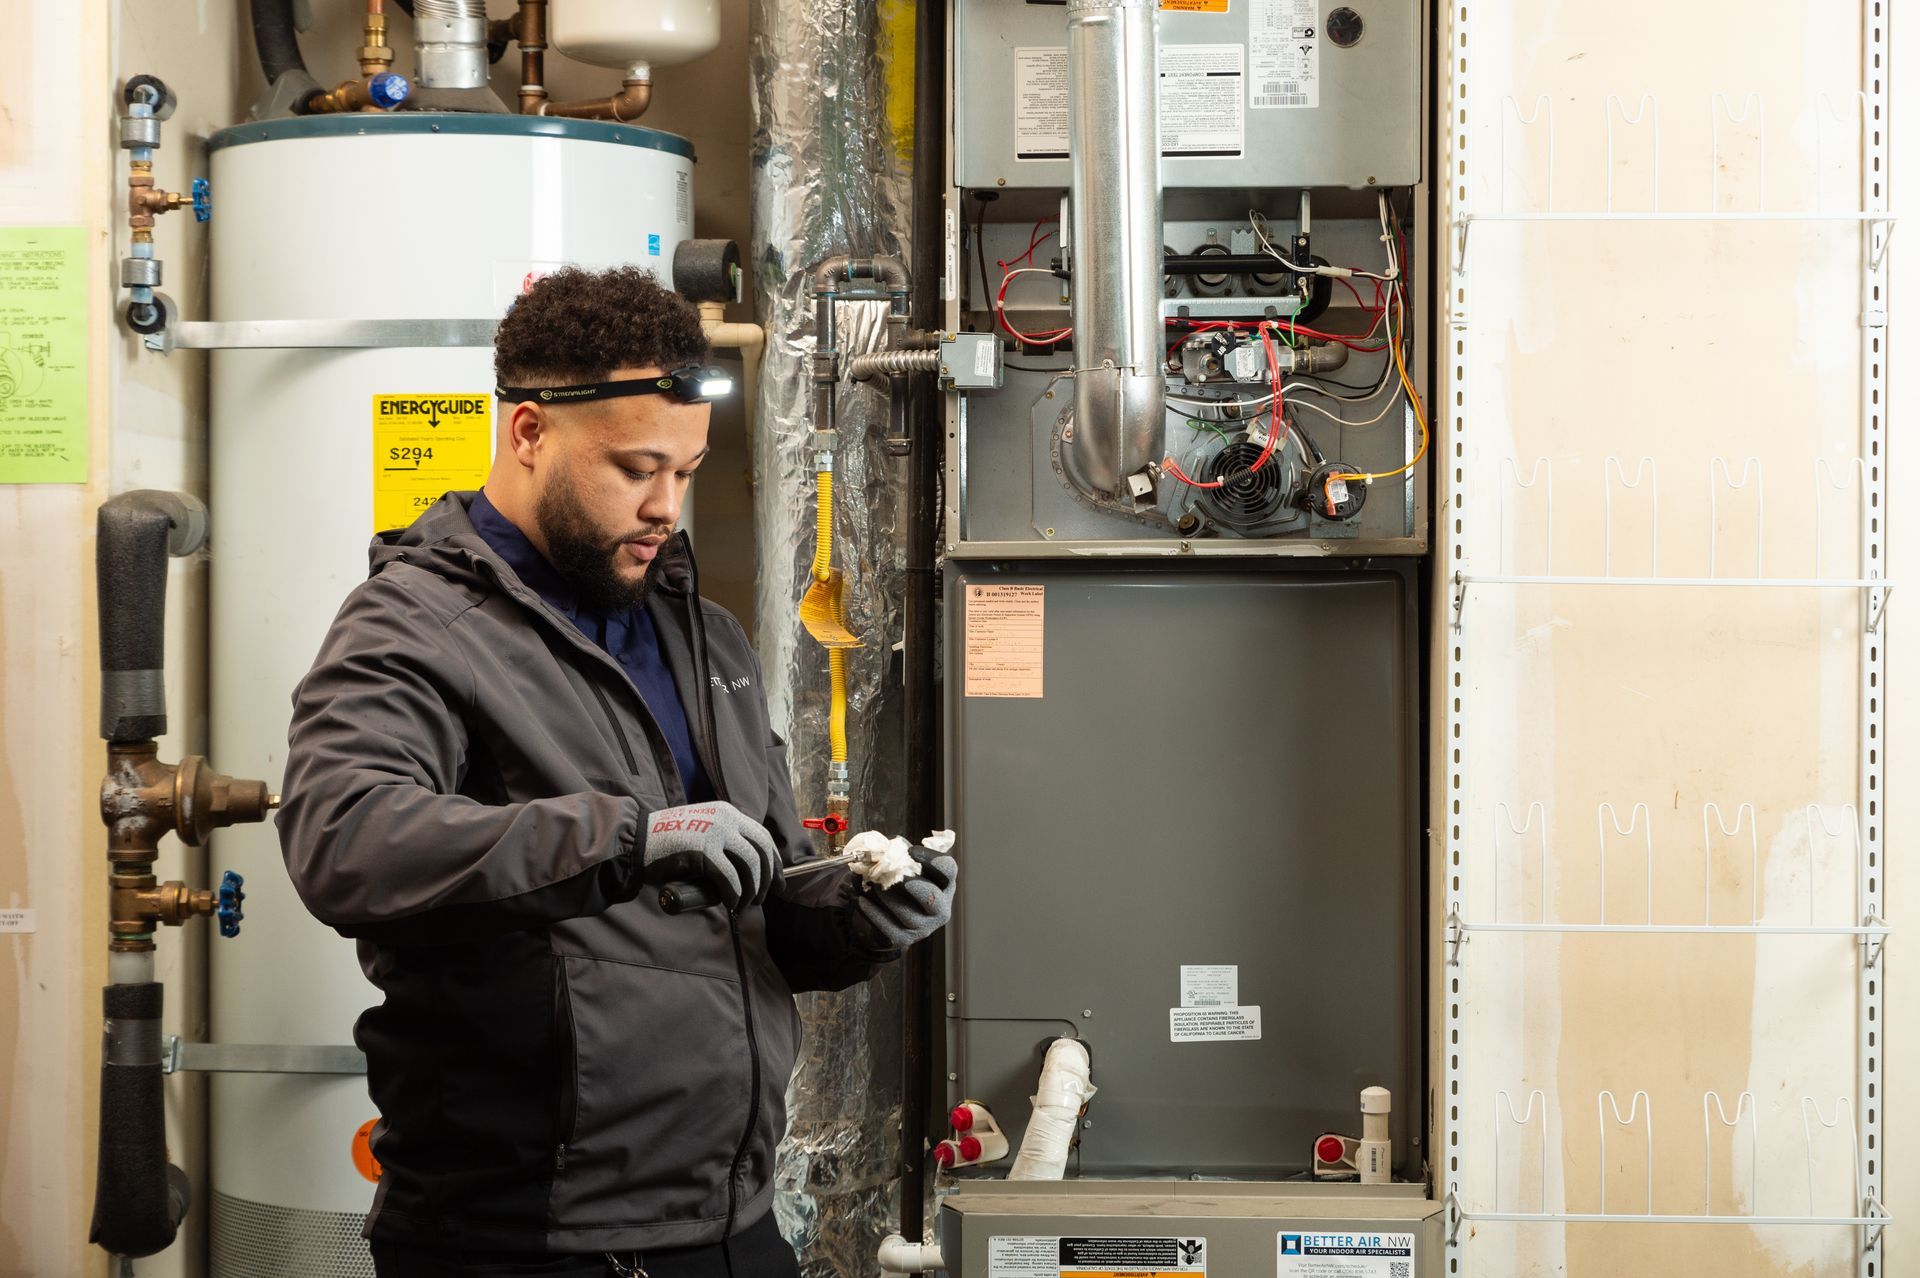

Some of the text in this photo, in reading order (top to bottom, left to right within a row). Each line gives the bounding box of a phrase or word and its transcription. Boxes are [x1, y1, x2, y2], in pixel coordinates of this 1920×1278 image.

[380, 400, 484, 415] ENERGYGUIDE
[390, 447, 433, 460] $294
[732, 676, 750, 690] NW
[652, 820, 714, 833] DEX FIT
[1304, 1236, 1411, 1247] BETTER AIR NW
